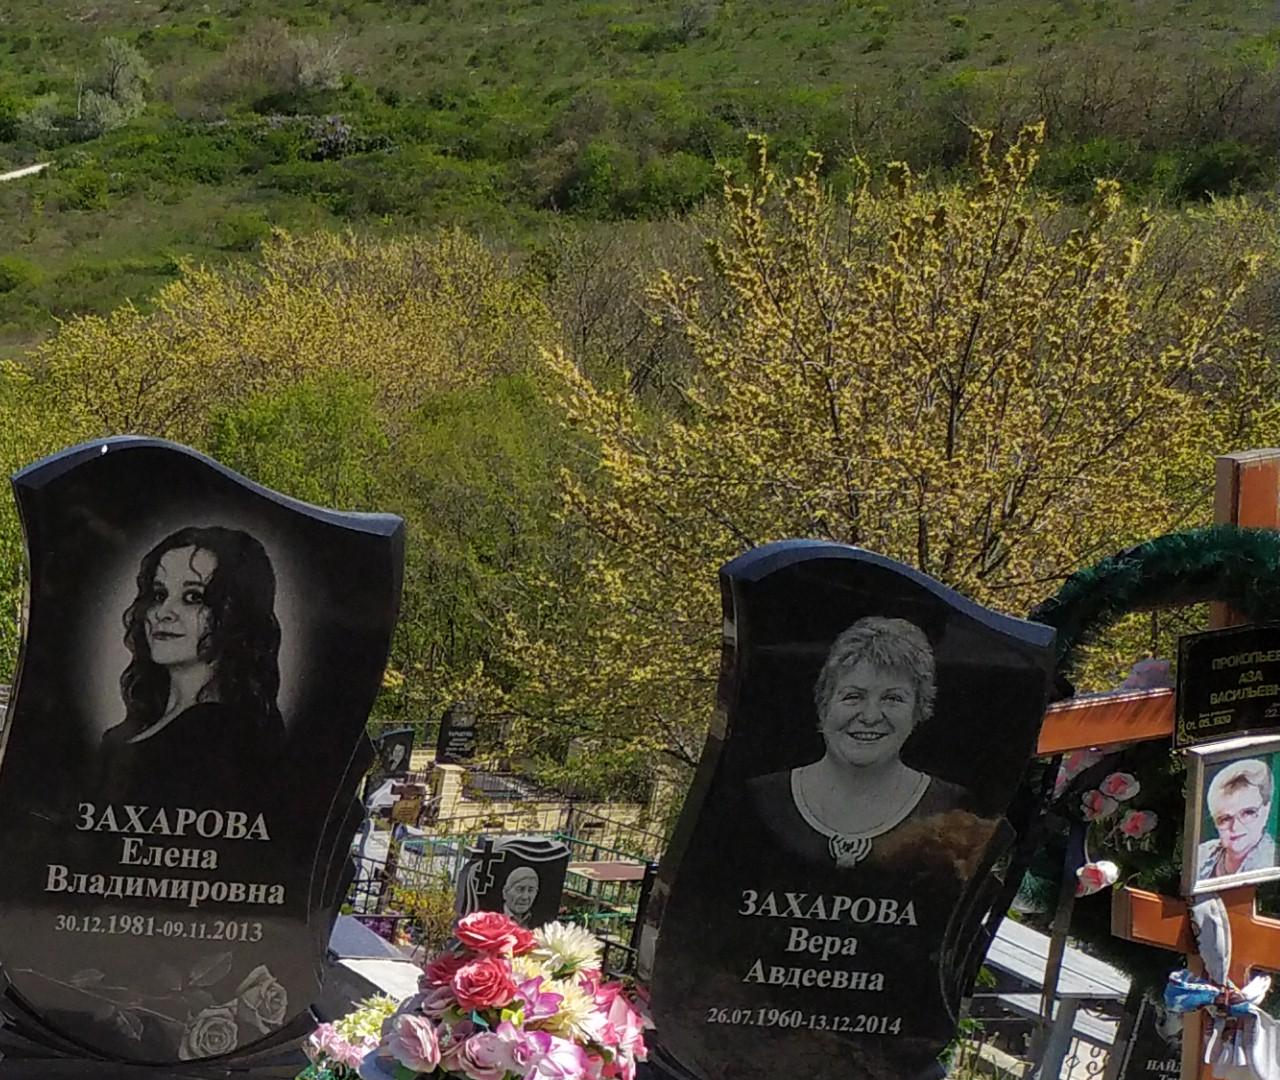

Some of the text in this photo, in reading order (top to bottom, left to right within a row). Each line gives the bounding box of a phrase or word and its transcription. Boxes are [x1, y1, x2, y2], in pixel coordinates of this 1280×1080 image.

[1239, 670, 1263, 684] АЗА
[75, 801, 271, 841] ЗАХАРОВА
[119, 836, 218, 869] Елена
[44, 864, 286, 908] Владимировна
[738, 890, 919, 927] ЗАХАРОВА
[55, 914, 263, 943] 30.12.1981-09.11.2013
[785, 926, 859, 961] Вера
[742, 958, 886, 992] Авдеевна
[706, 1006, 903, 1035] 26.07.1960-13.12.2014
